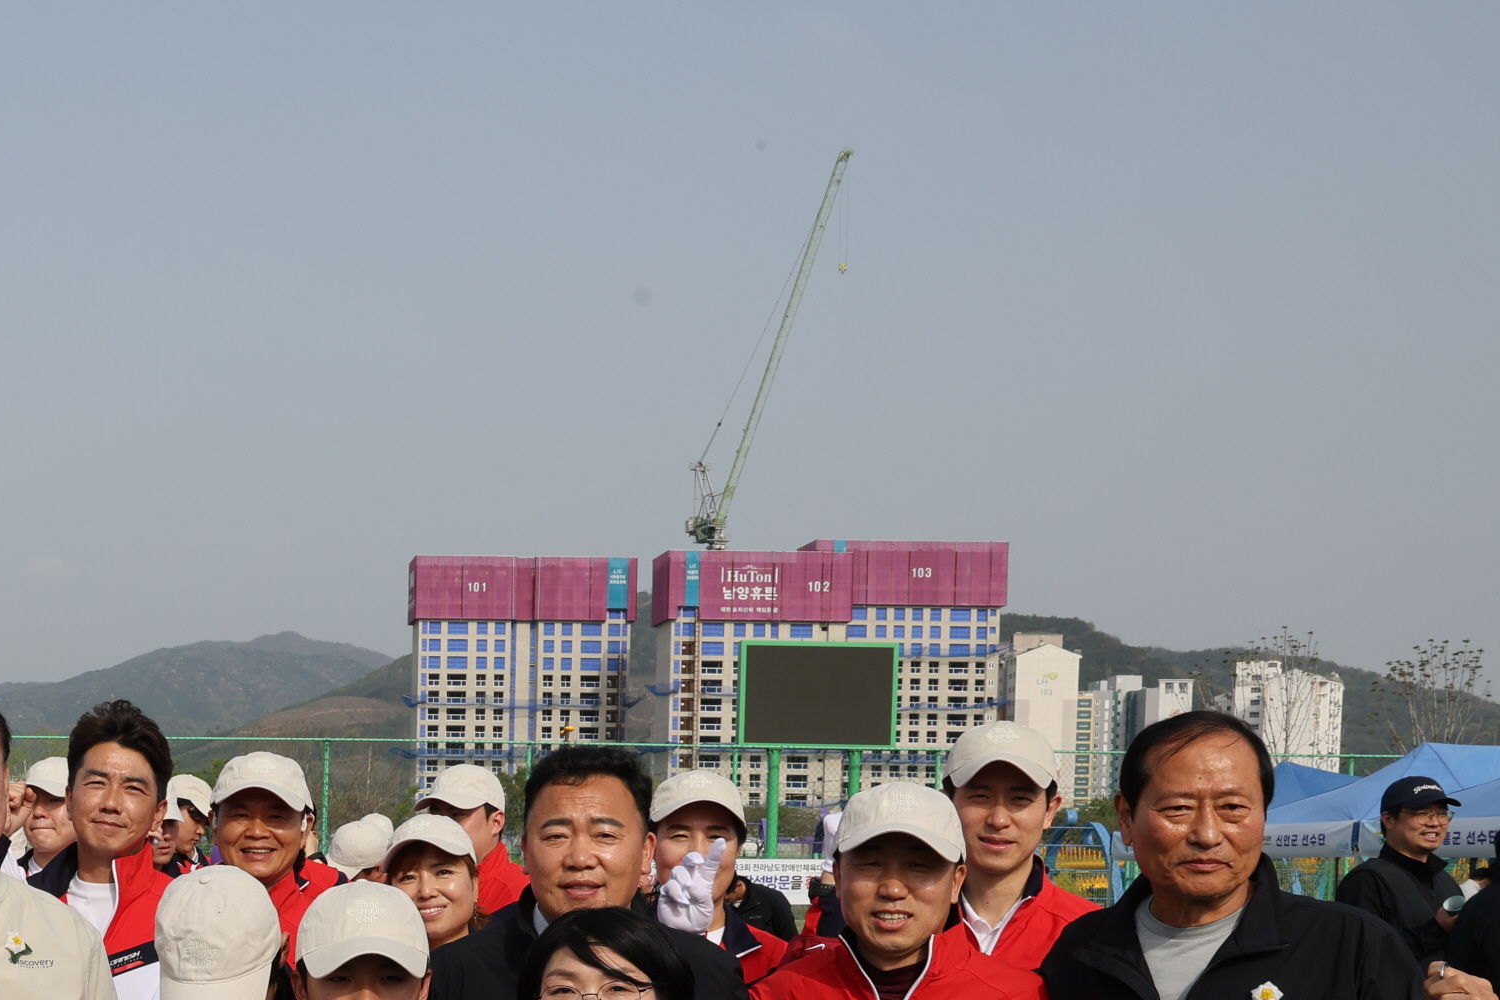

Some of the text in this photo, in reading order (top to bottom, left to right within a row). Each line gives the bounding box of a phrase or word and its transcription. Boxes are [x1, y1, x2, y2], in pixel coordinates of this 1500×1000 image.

[727, 570, 772, 583] HuTon
[912, 567, 932, 578] 103
[467, 582, 487, 592] 101
[808, 581, 830, 592] 102
[722, 586, 779, 601] 남양휴튼
[1276, 834, 1298, 847] 신안군
[1301, 833, 1326, 847] 선수단
[1442, 831, 1461, 846] 흥군
[735, 863, 751, 872] 33회
[9, 958, 54, 968] iscovery
